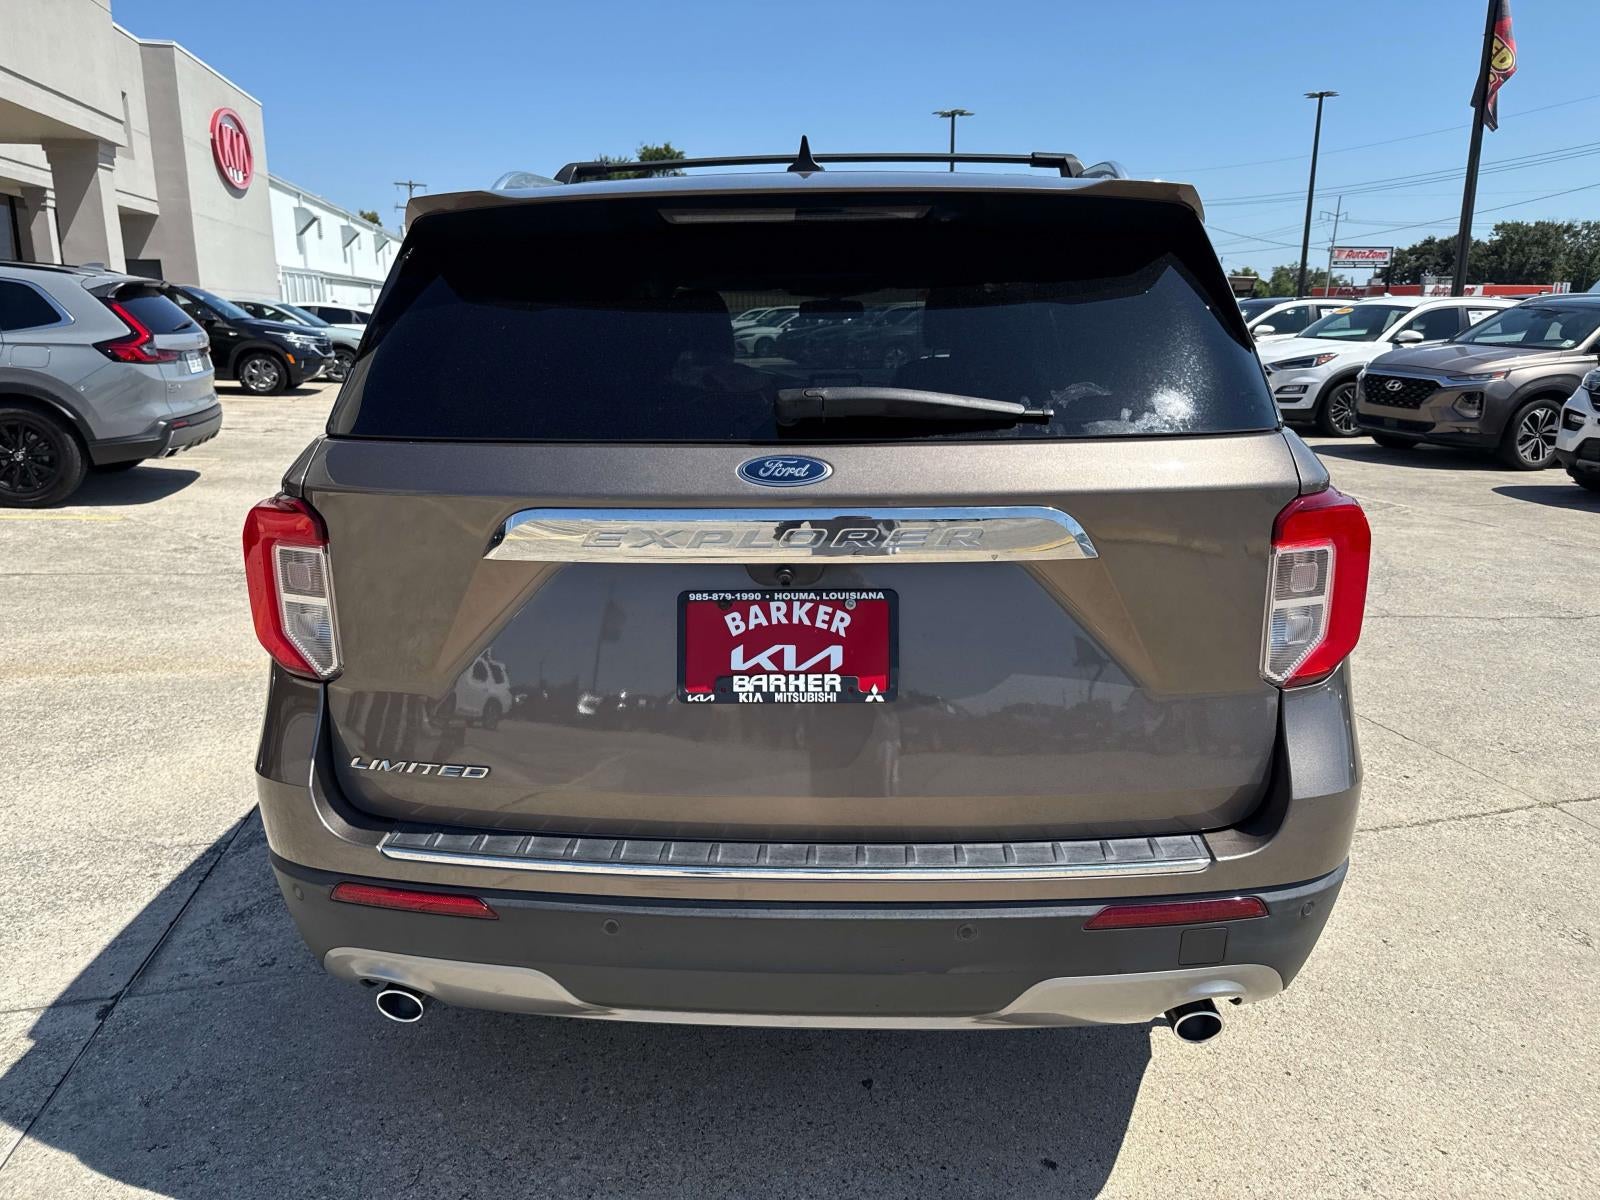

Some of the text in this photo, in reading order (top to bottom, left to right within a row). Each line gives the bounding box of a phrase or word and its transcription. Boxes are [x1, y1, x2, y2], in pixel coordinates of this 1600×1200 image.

[1345, 249, 1388, 259] AutoZone
[758, 460, 810, 477] Ford
[581, 526, 985, 549] EXPLORER
[688, 591, 885, 601] 985-879-1990 HOUMA, LOUISIANA
[724, 600, 852, 637] BARKER
[730, 644, 843, 672] KIA
[738, 691, 837, 703] KIA MITSUBISHI
[350, 756, 490, 779] LIMITED
